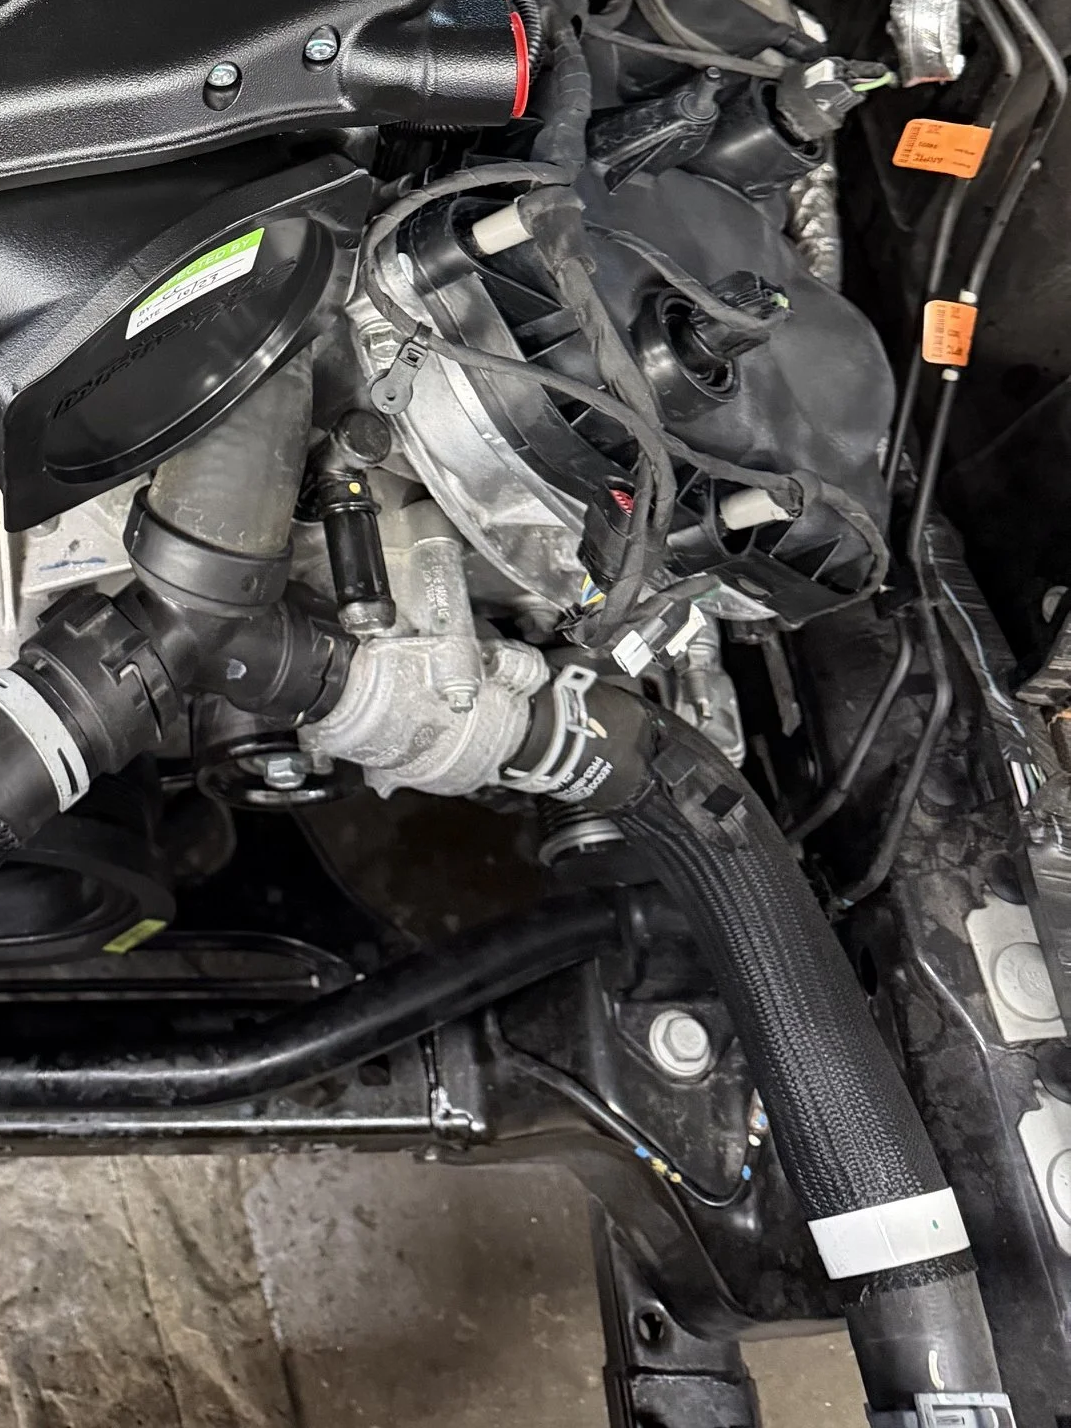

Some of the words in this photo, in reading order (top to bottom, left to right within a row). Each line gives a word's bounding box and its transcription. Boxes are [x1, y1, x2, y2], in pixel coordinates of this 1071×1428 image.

[230, 238, 251, 252] BY
[138, 305, 151, 317] BY
[136, 309, 161, 328] DATE
